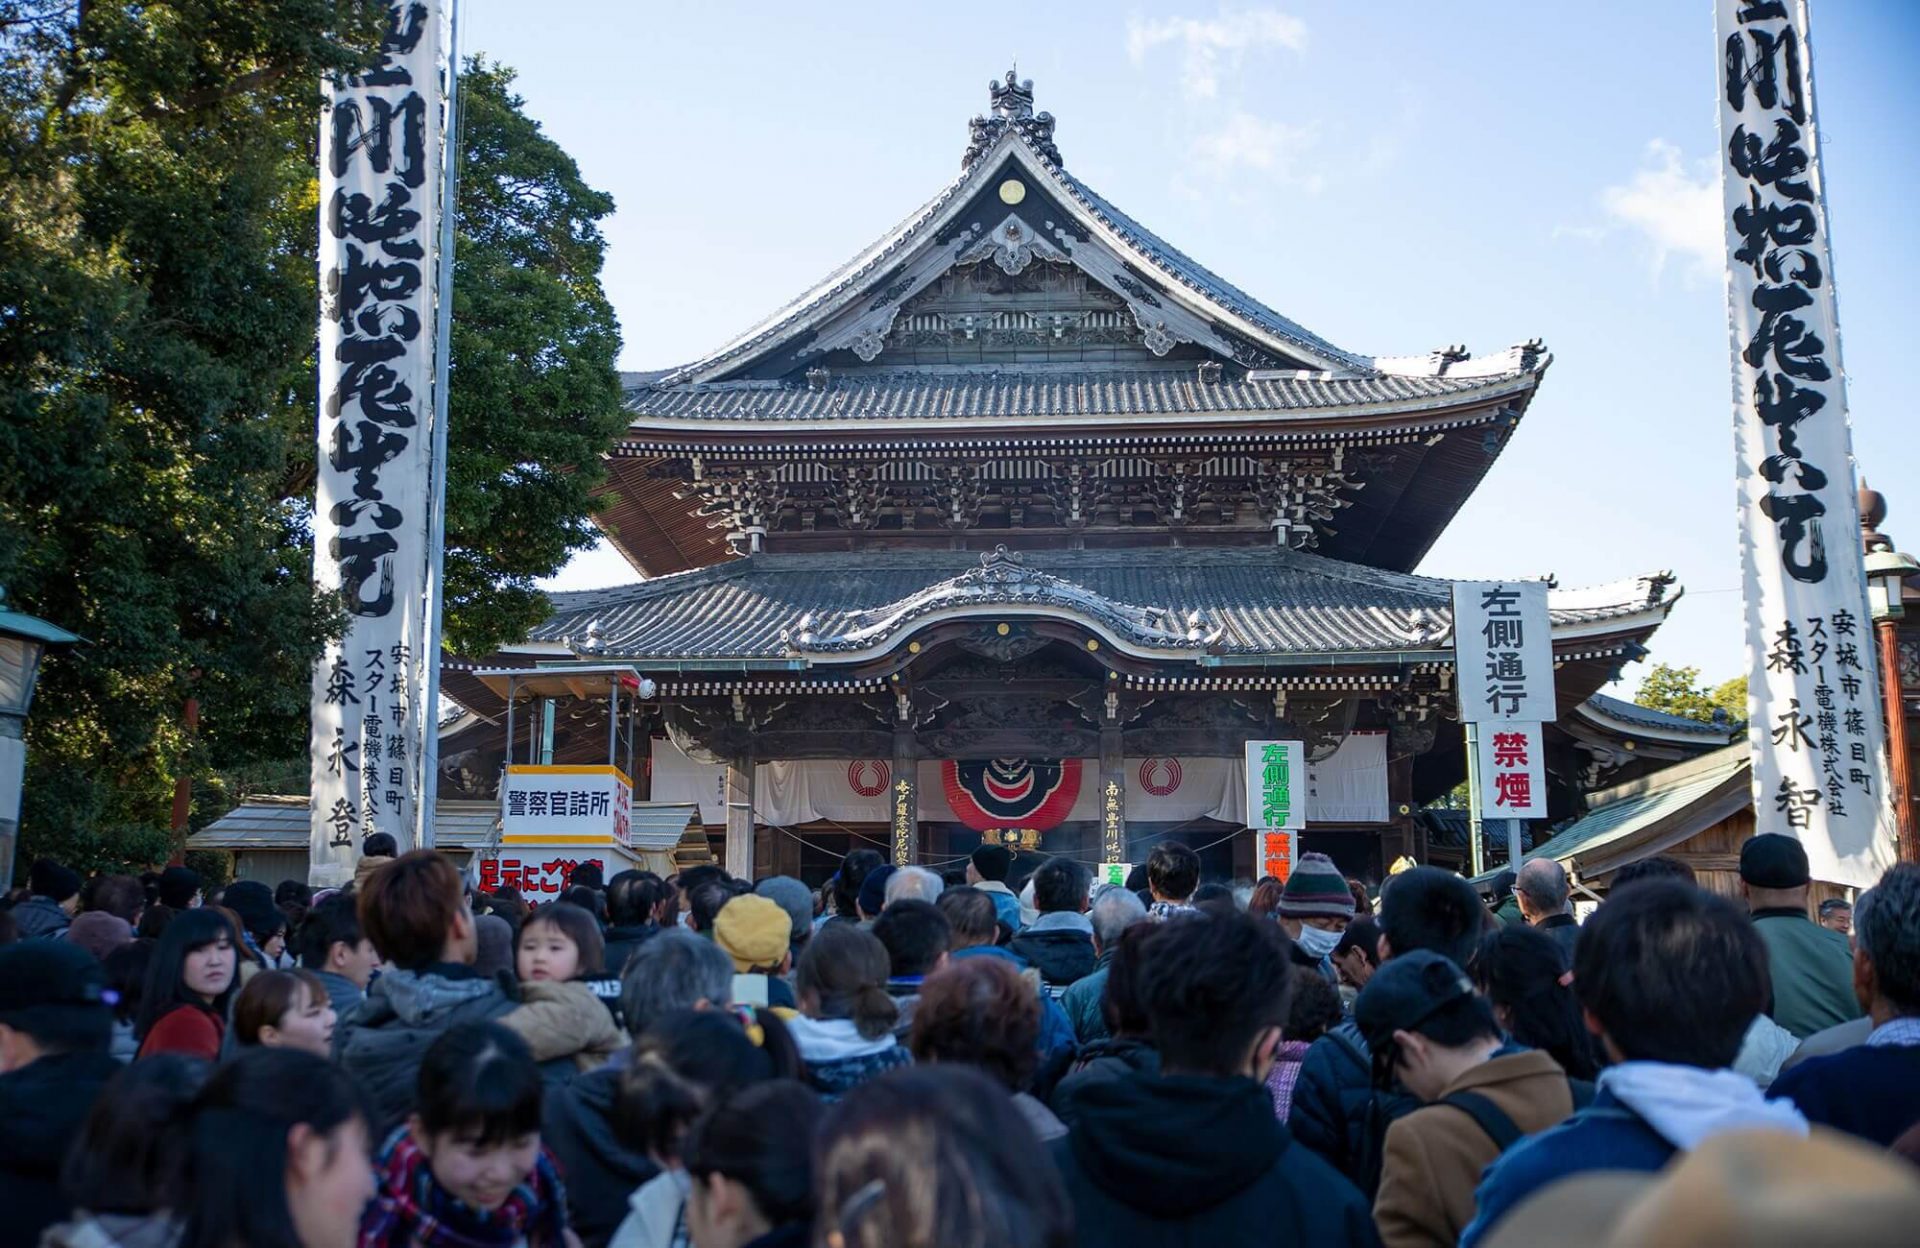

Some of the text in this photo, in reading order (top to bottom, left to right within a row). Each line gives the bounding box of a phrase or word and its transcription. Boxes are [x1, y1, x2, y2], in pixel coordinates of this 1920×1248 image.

[385, 641, 410, 816] 安城市篠目町
[1481, 588, 1527, 715] 左側通行
[1766, 620, 1823, 829] 森永智
[1807, 617, 1848, 817] スター電機株式会社
[1831, 608, 1871, 795] 安城市篠目町
[325, 656, 361, 848] 森永登
[361, 649, 385, 839] スター電機株式会社
[508, 791, 610, 817] 警察官詰所
[1261, 743, 1290, 827] 左側通行
[1493, 732, 1531, 807] 禁煙
